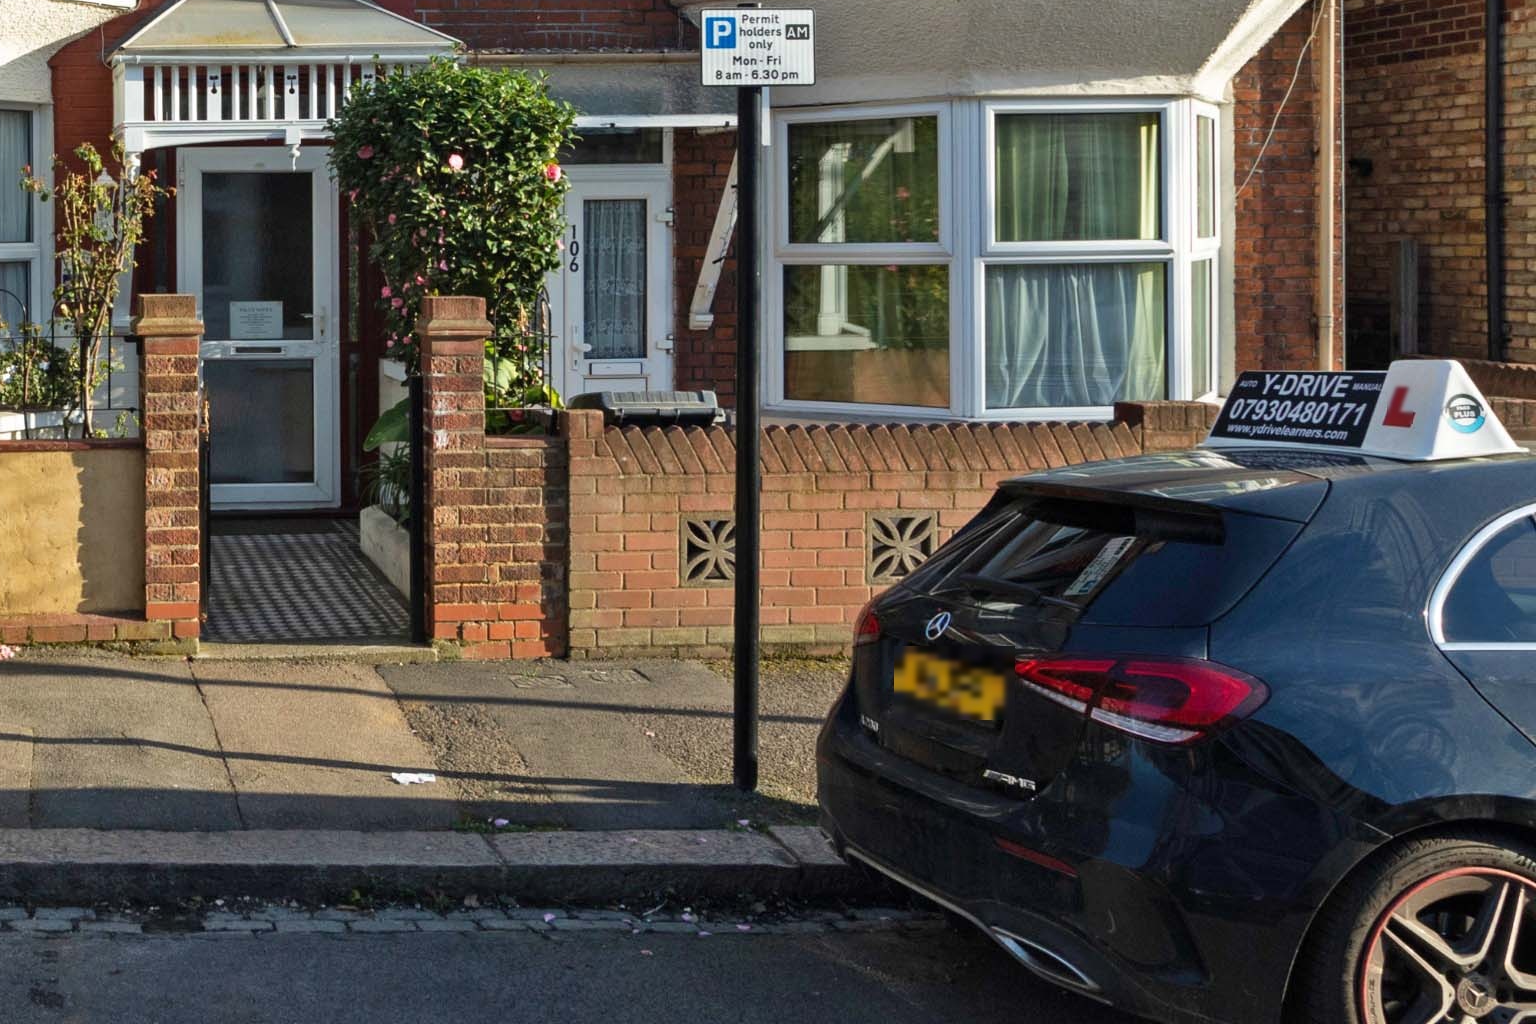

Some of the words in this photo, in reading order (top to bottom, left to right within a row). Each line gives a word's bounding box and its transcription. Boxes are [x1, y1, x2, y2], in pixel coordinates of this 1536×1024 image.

[741, 14, 780, 24] Permit
[713, 20, 732, 46] P
[739, 27, 782, 37] holders
[786, 26, 808, 38] AM
[749, 40, 773, 51] only
[732, 56, 757, 66] Mon
[766, 56, 782, 66] Fri
[715, 70, 723, 80] 8
[726, 72, 742, 80] am
[751, 70, 779, 80] 6.30
[782, 72, 799, 81] pm
[569, 224, 579, 273] 106
[1238, 379, 1259, 388] AUTO
[1262, 374, 1353, 398] Y-DRIVE
[1352, 382, 1384, 392] MANUAL
[1229, 398, 1367, 426] 07930480171
[1382, 384, 1417, 429] L
[1453, 410, 1476, 418] PLUS
[1227, 423, 1348, 441] www.ydrivelearners.com
